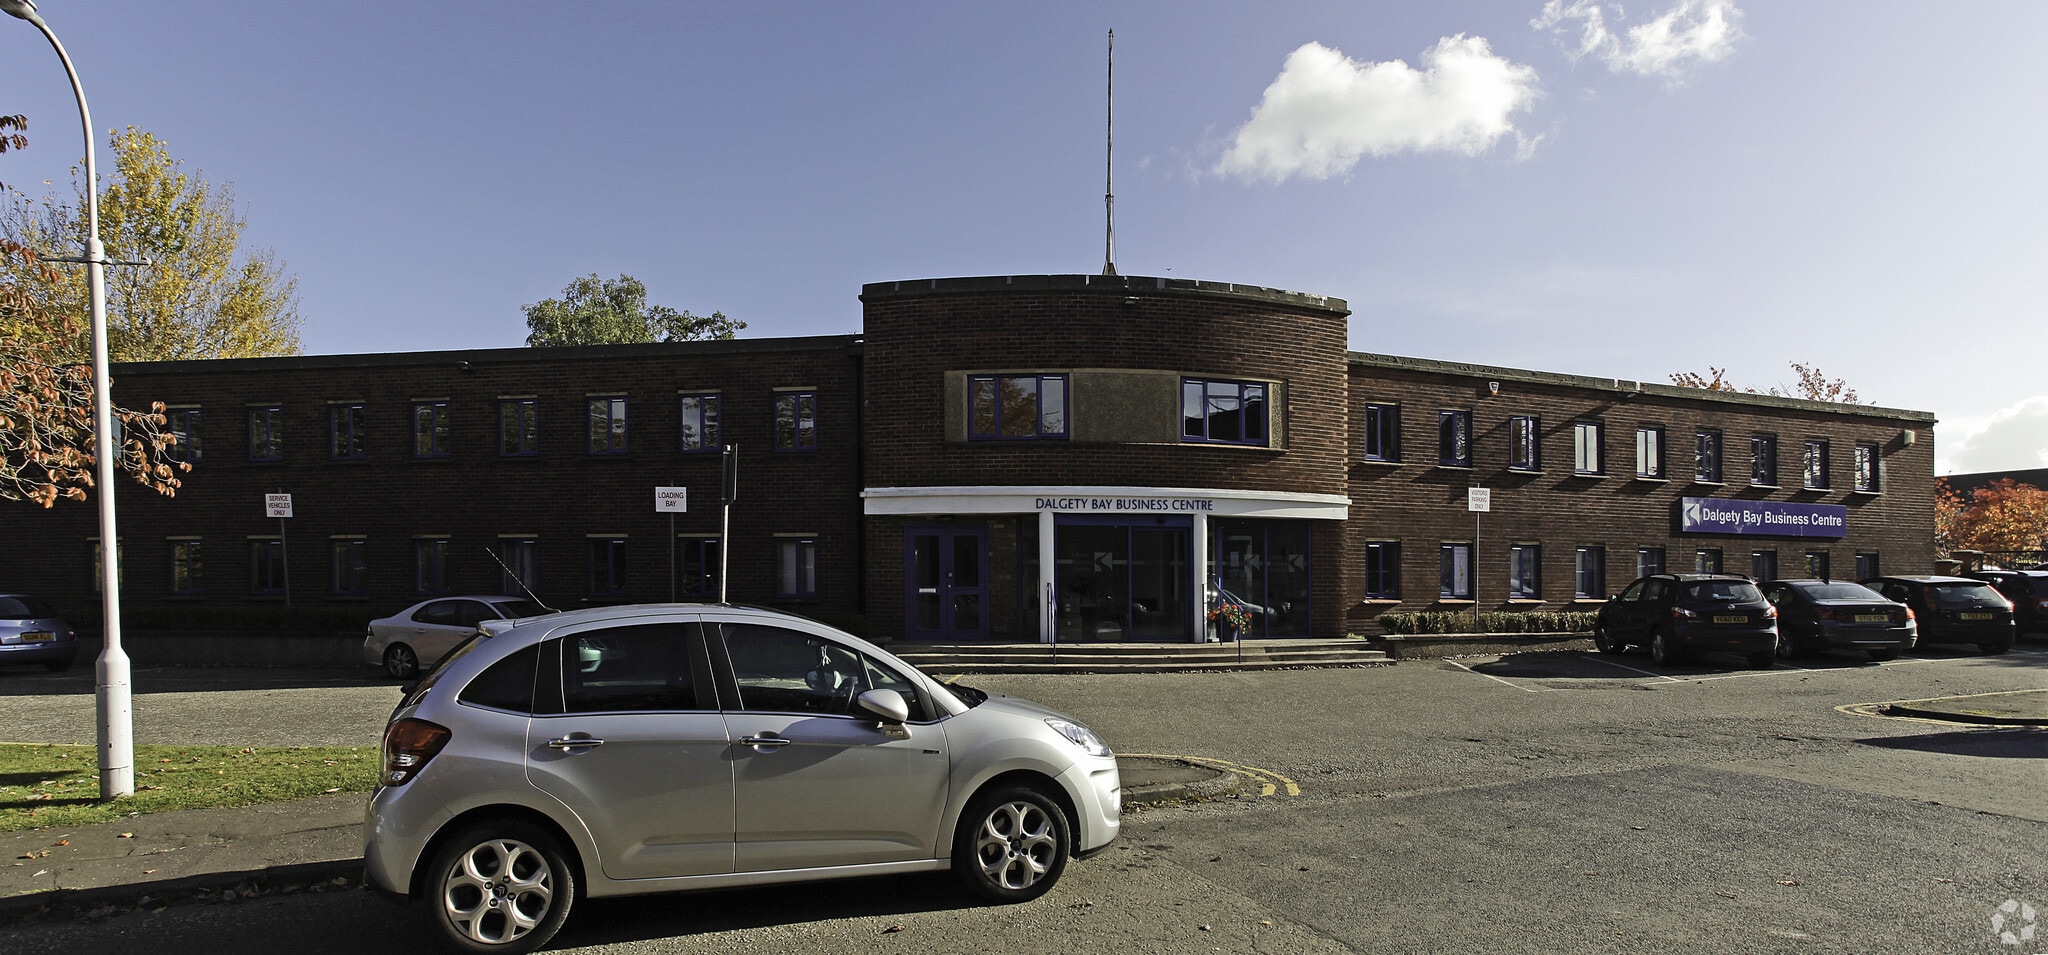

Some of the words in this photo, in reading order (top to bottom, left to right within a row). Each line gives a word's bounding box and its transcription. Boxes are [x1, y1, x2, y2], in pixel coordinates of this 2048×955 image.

[1035, 498, 1089, 510] DALGETY
[1091, 499, 1113, 510] BAY
[1116, 499, 1169, 510] BUSINESS
[1172, 500, 1213, 511] CENTRE
[1702, 508, 1741, 524] Dalgety
[1743, 510, 1762, 526] Bay
[1764, 511, 1809, 525] Business
[1811, 513, 1842, 527] Centre
